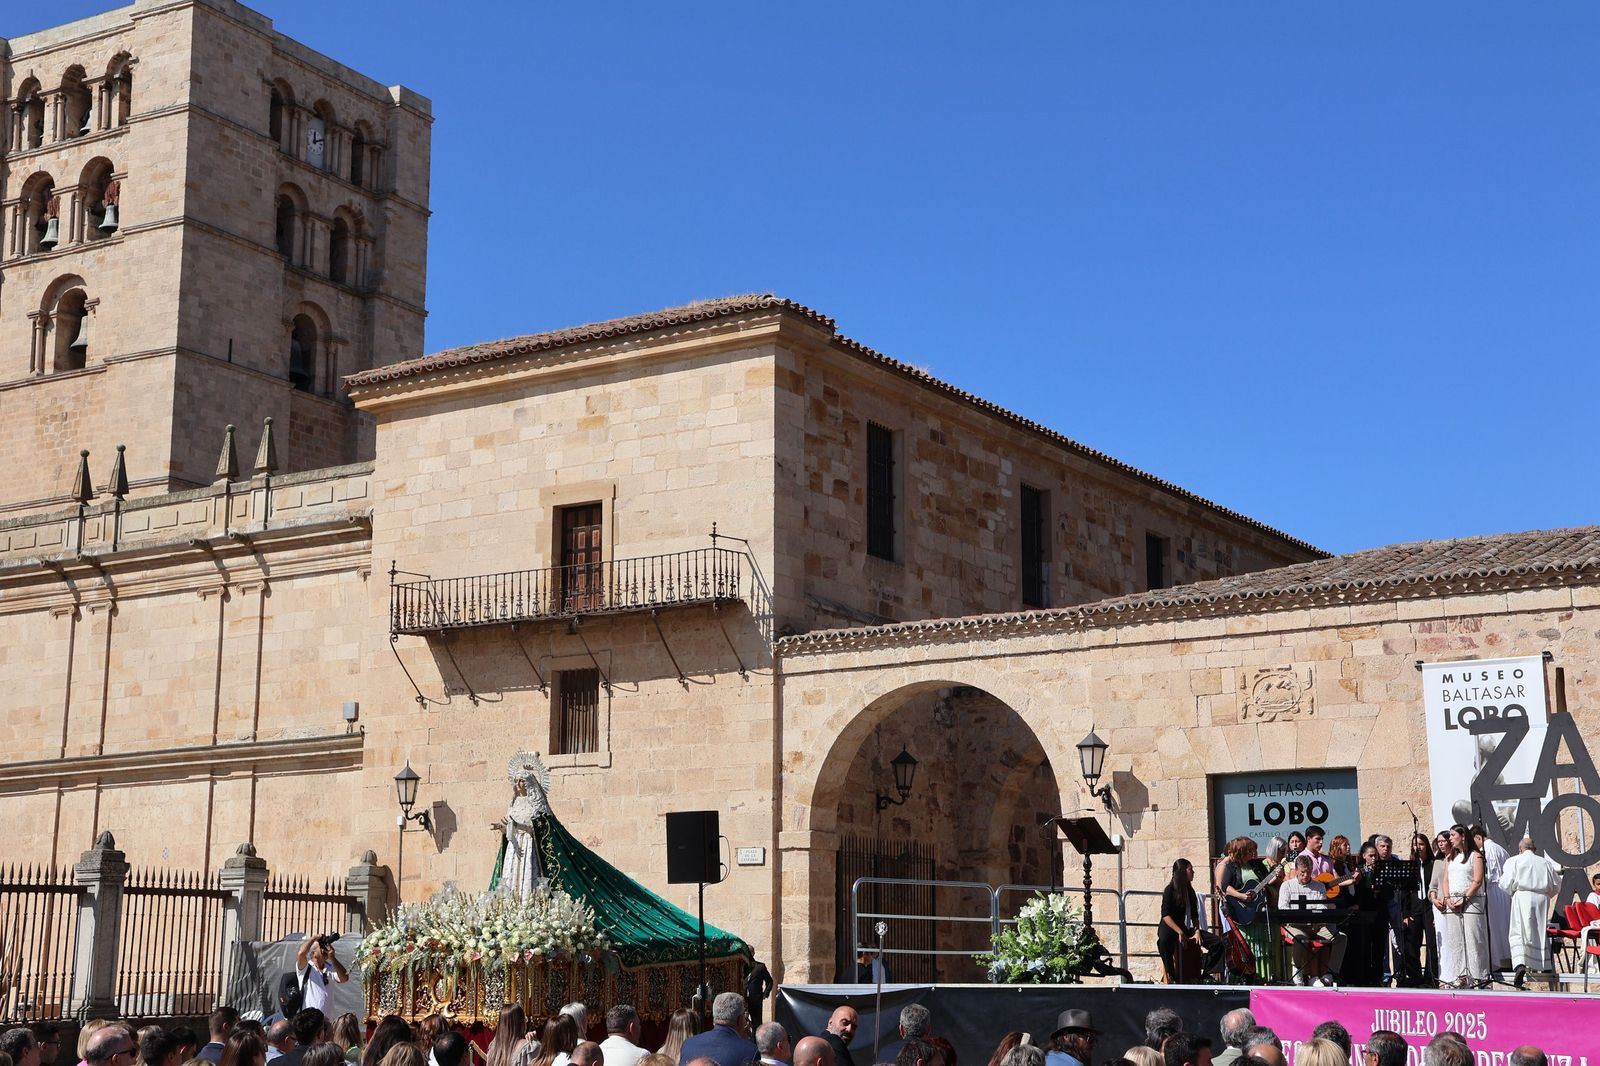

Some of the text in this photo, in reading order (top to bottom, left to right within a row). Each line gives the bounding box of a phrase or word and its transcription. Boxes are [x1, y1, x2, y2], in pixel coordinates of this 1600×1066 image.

[1442, 669, 1524, 683] MUSEO
[1442, 685, 1525, 702] BALTASAR
[1247, 781, 1326, 798] BALTASAR
[1248, 800, 1329, 826] LOBO
[1370, 1008, 1487, 1040] JUBILEO 2025
